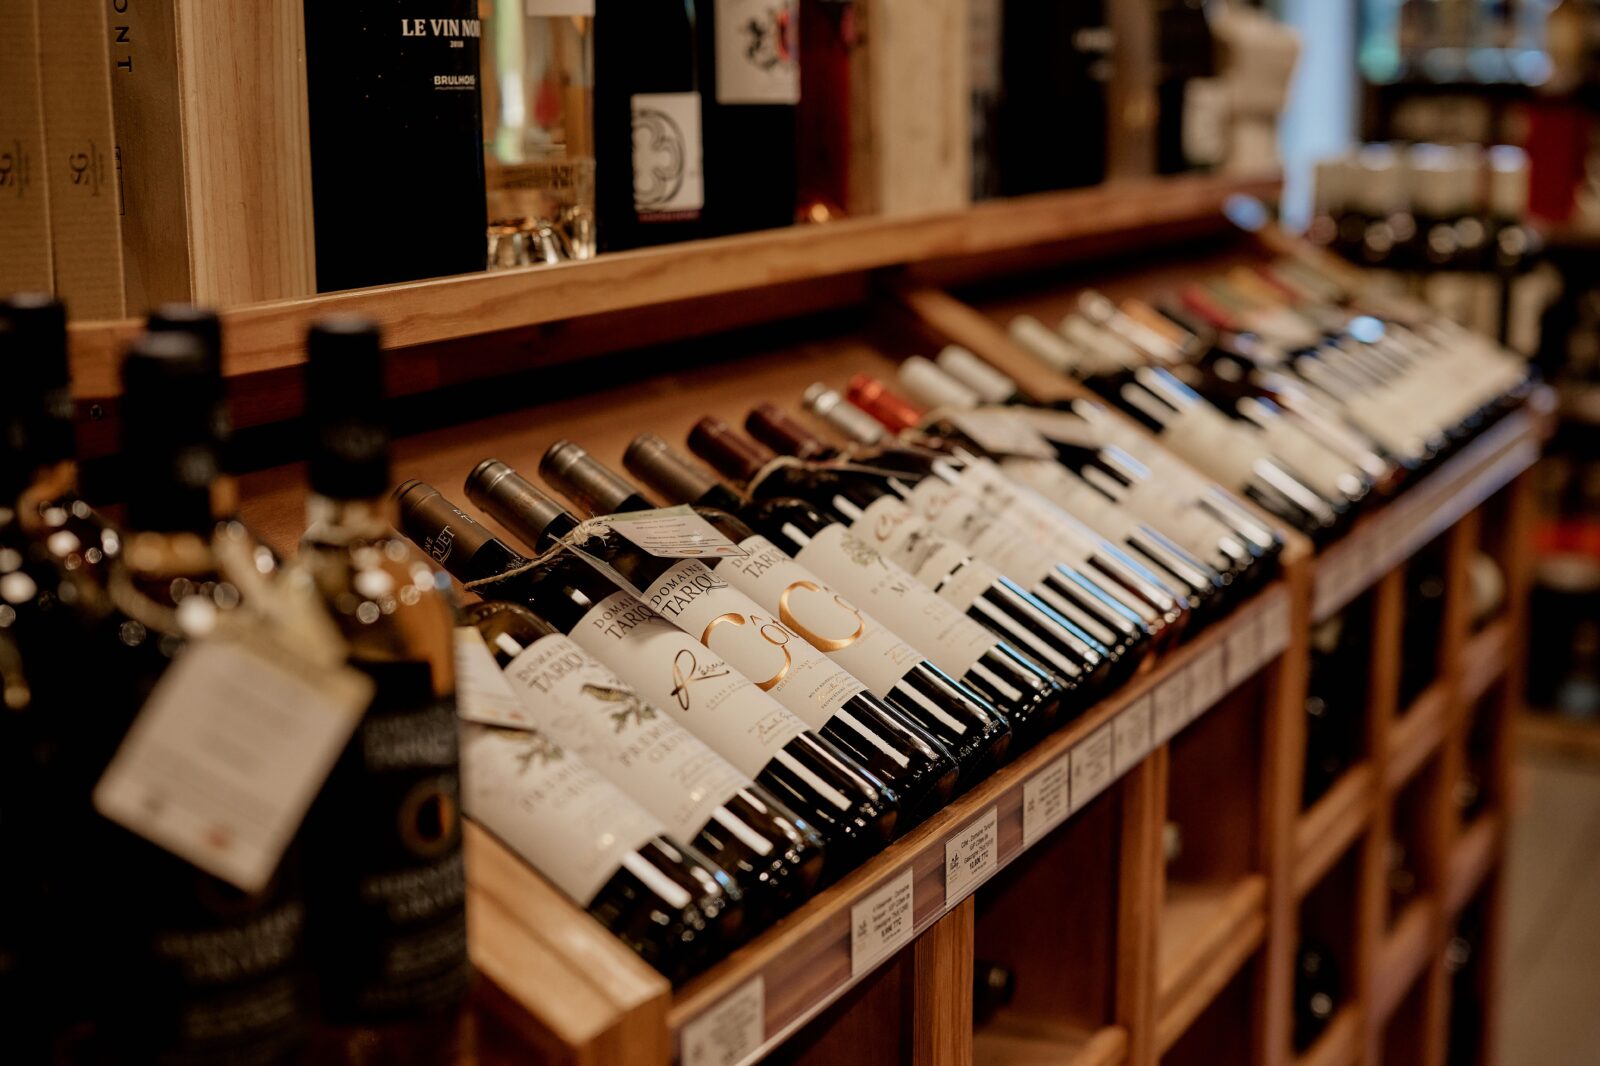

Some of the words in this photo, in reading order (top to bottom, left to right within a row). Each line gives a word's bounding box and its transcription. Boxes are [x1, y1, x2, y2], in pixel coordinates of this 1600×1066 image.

[401, 19, 426, 37] LE
[430, 19, 459, 37] VIN
[650, 563, 703, 608] DOMAINE
[592, 595, 639, 629] DOMAIN
